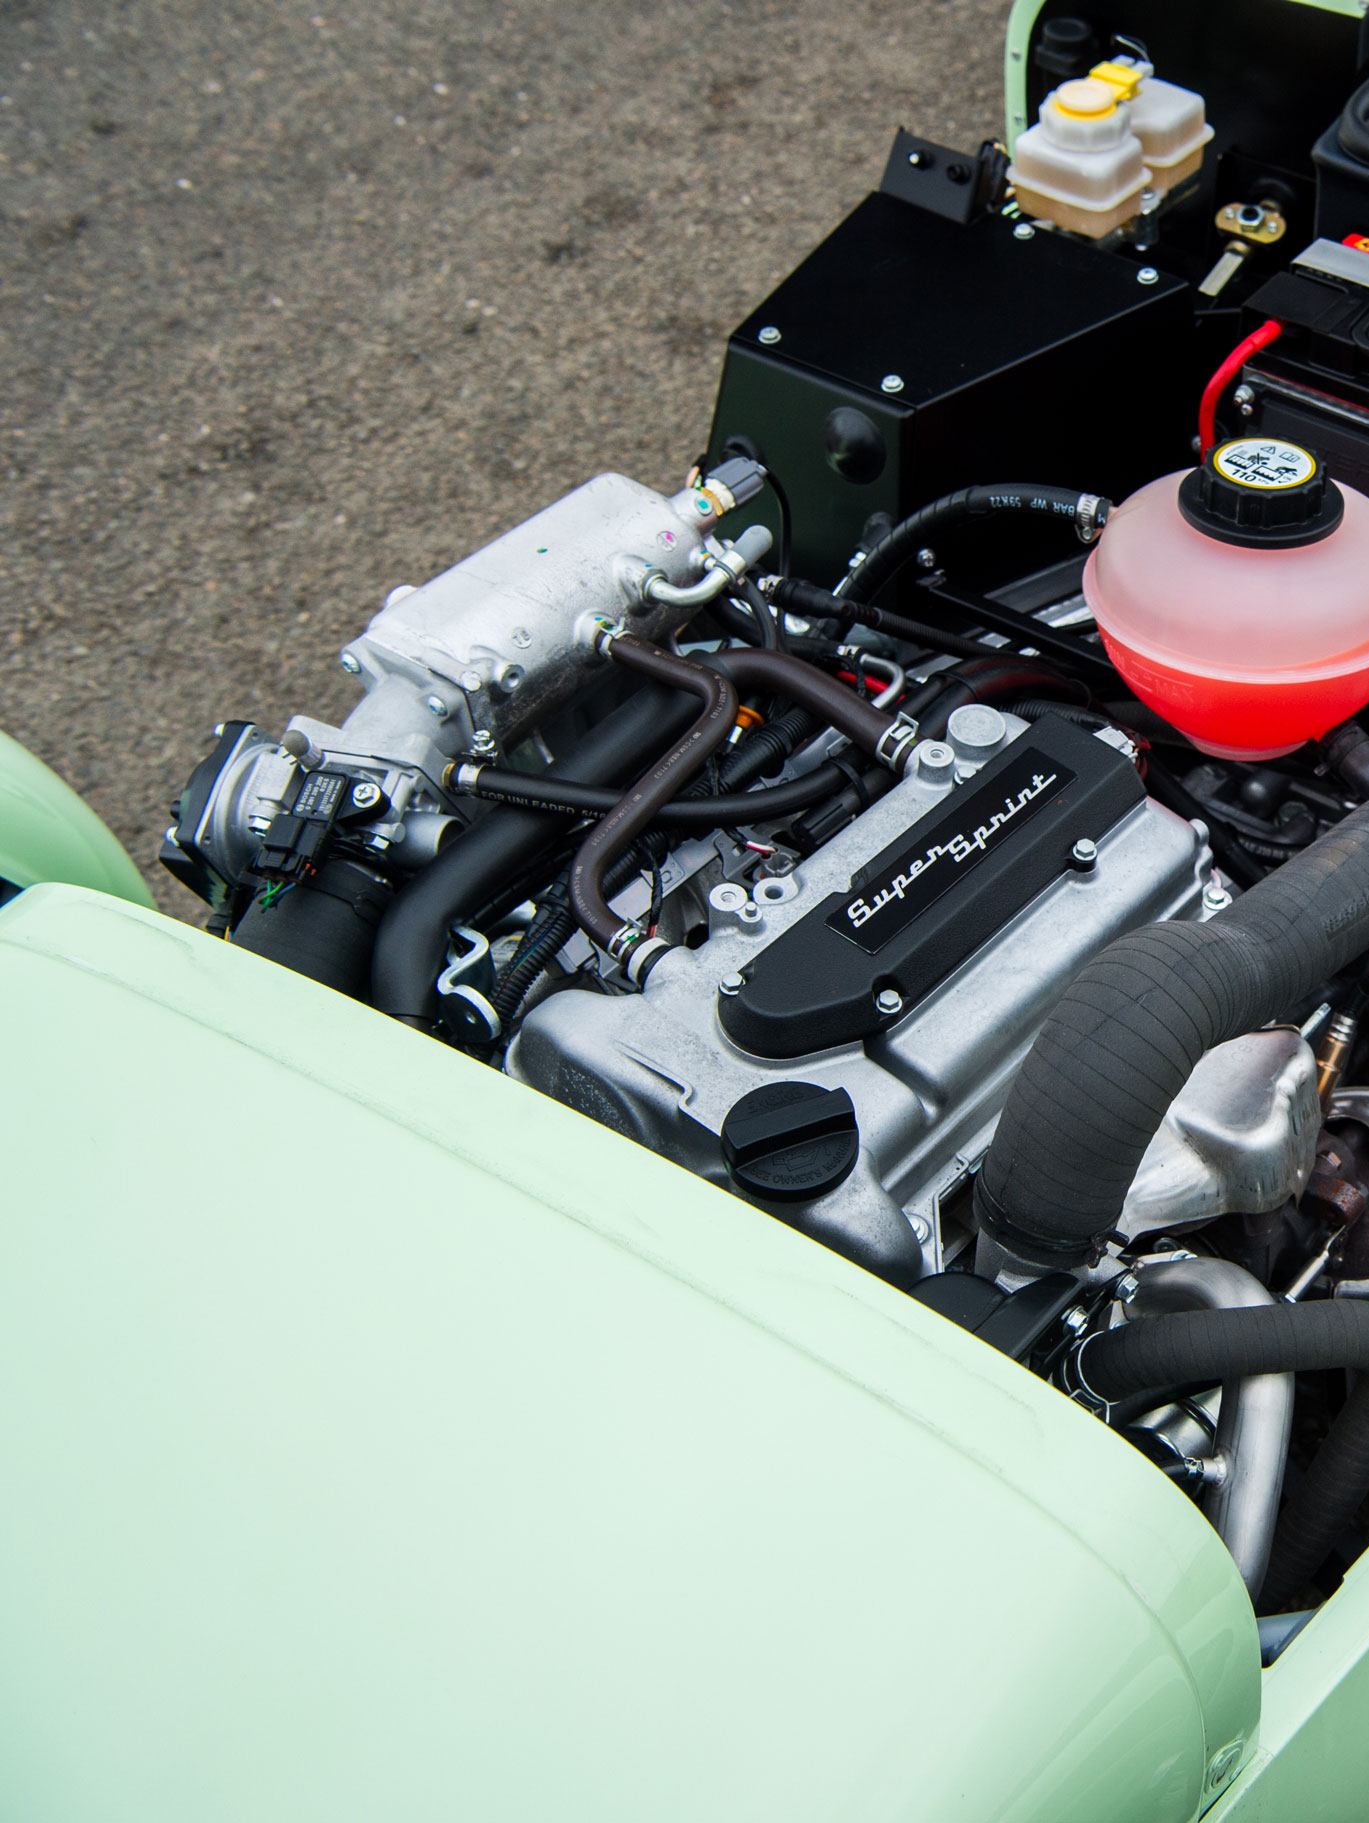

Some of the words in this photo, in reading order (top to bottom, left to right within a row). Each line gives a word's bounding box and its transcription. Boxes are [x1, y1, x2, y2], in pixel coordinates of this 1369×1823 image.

[1231, 468, 1257, 483] 110
[1030, 497, 1048, 509] WP
[1053, 501, 1076, 516] BAR
[1155, 679, 1195, 704] MAX
[299, 783, 313, 804] BOSCH
[480, 790, 505, 801] FOR
[507, 794, 576, 814] UNLEADED
